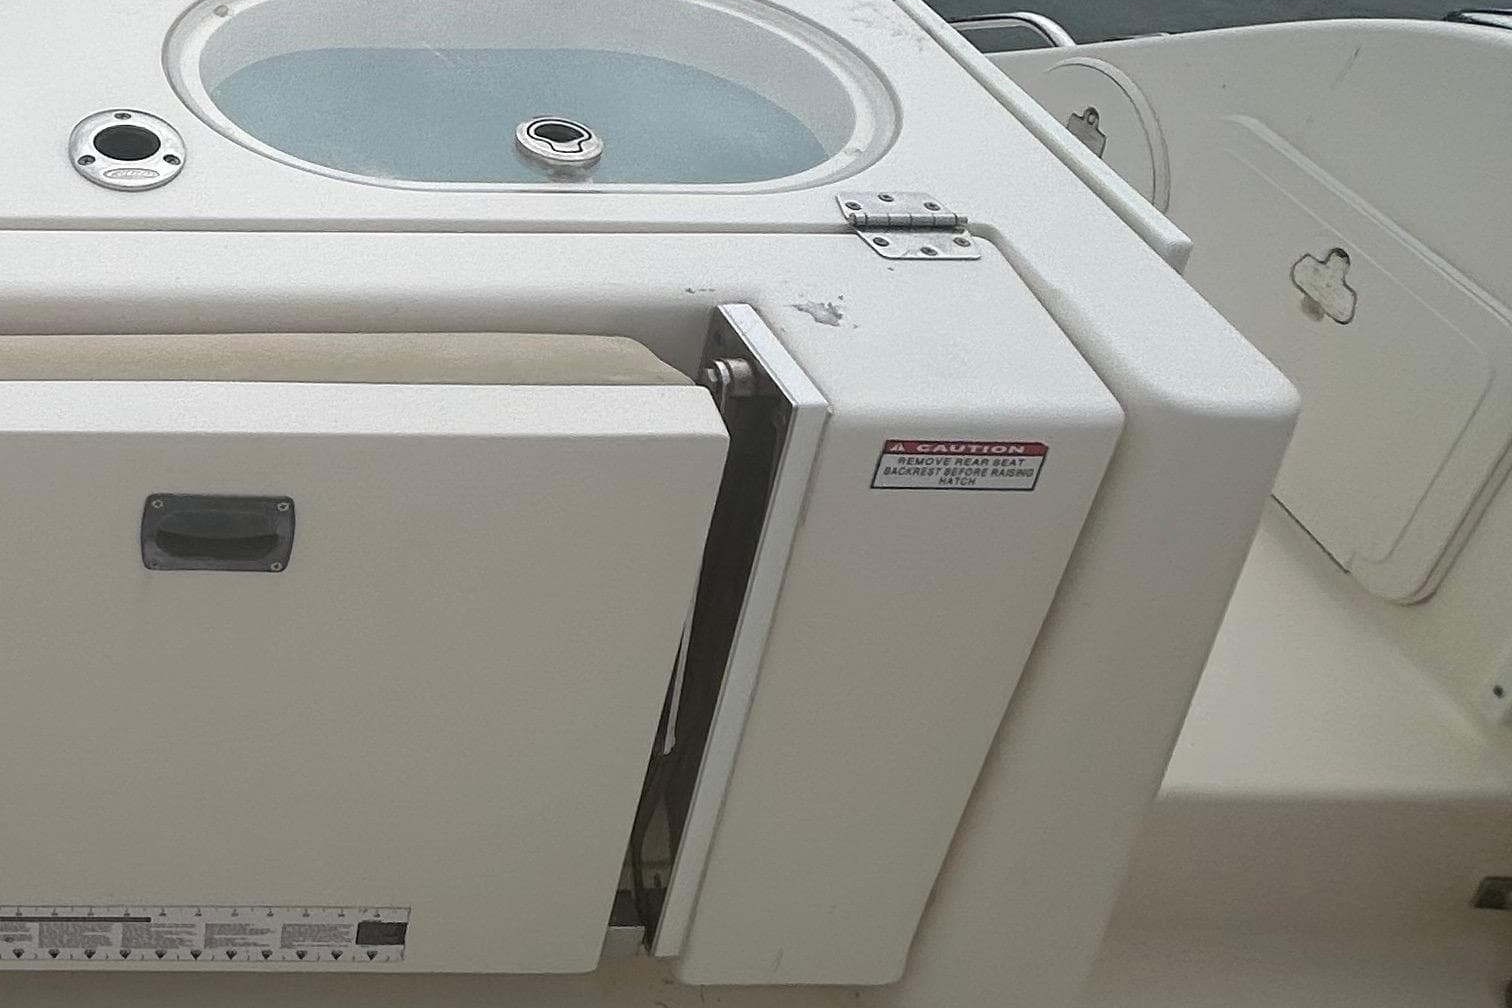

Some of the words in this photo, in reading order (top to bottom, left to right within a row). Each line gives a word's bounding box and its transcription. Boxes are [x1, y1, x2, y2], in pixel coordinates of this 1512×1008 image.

[916, 444, 1025, 454] CAUTION
[897, 456, 951, 466] REMOVE
[954, 457, 989, 467] REAR
[992, 458, 1026, 467] SEAT
[883, 466, 941, 476] BACKREST
[943, 467, 988, 477] BEFORE
[990, 468, 1034, 478] RAISING
[938, 476, 976, 486] HATCH
